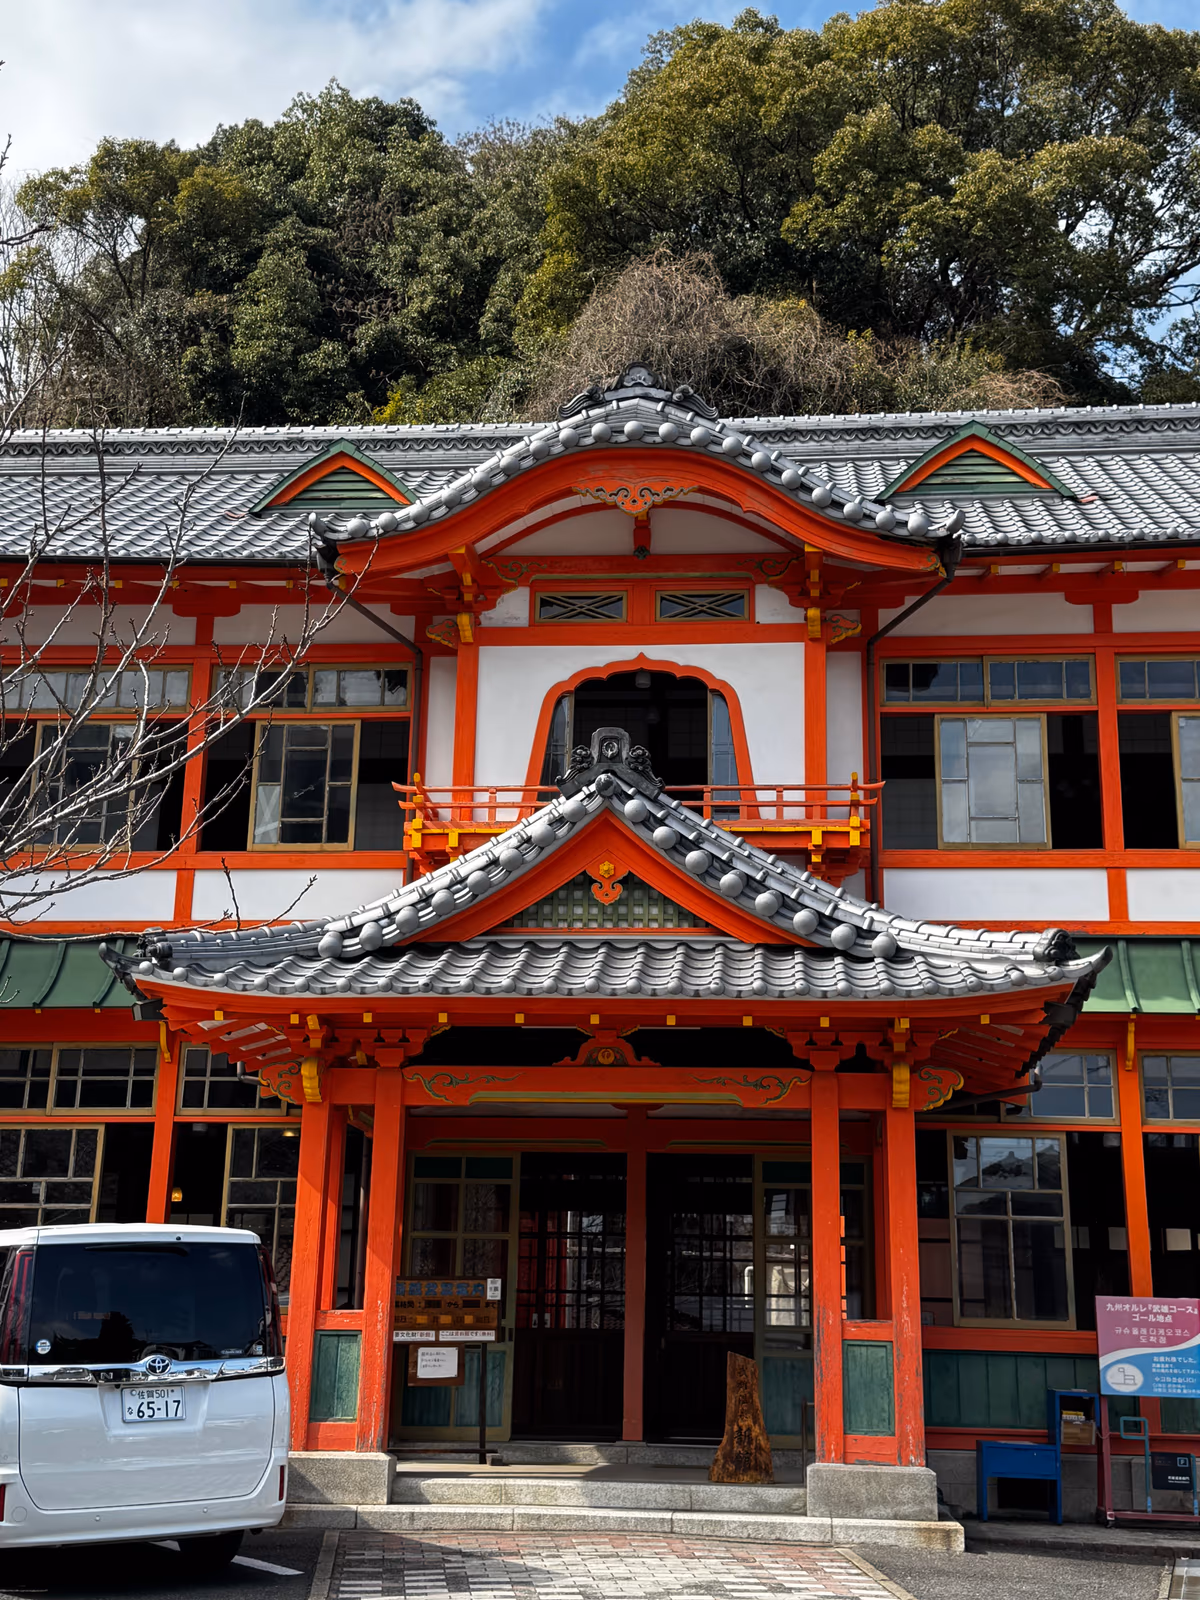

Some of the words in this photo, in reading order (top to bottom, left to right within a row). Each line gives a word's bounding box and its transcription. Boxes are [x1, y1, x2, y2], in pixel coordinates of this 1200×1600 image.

[1106, 1303, 1198, 1314] 九州オルレ『武雄コース』
[1132, 1314, 1173, 1323] ゴール地点
[137, 1389, 169, 1399] 佐賀501
[127, 1406, 134, 1415] な
[137, 1400, 181, 1418] 65-17
